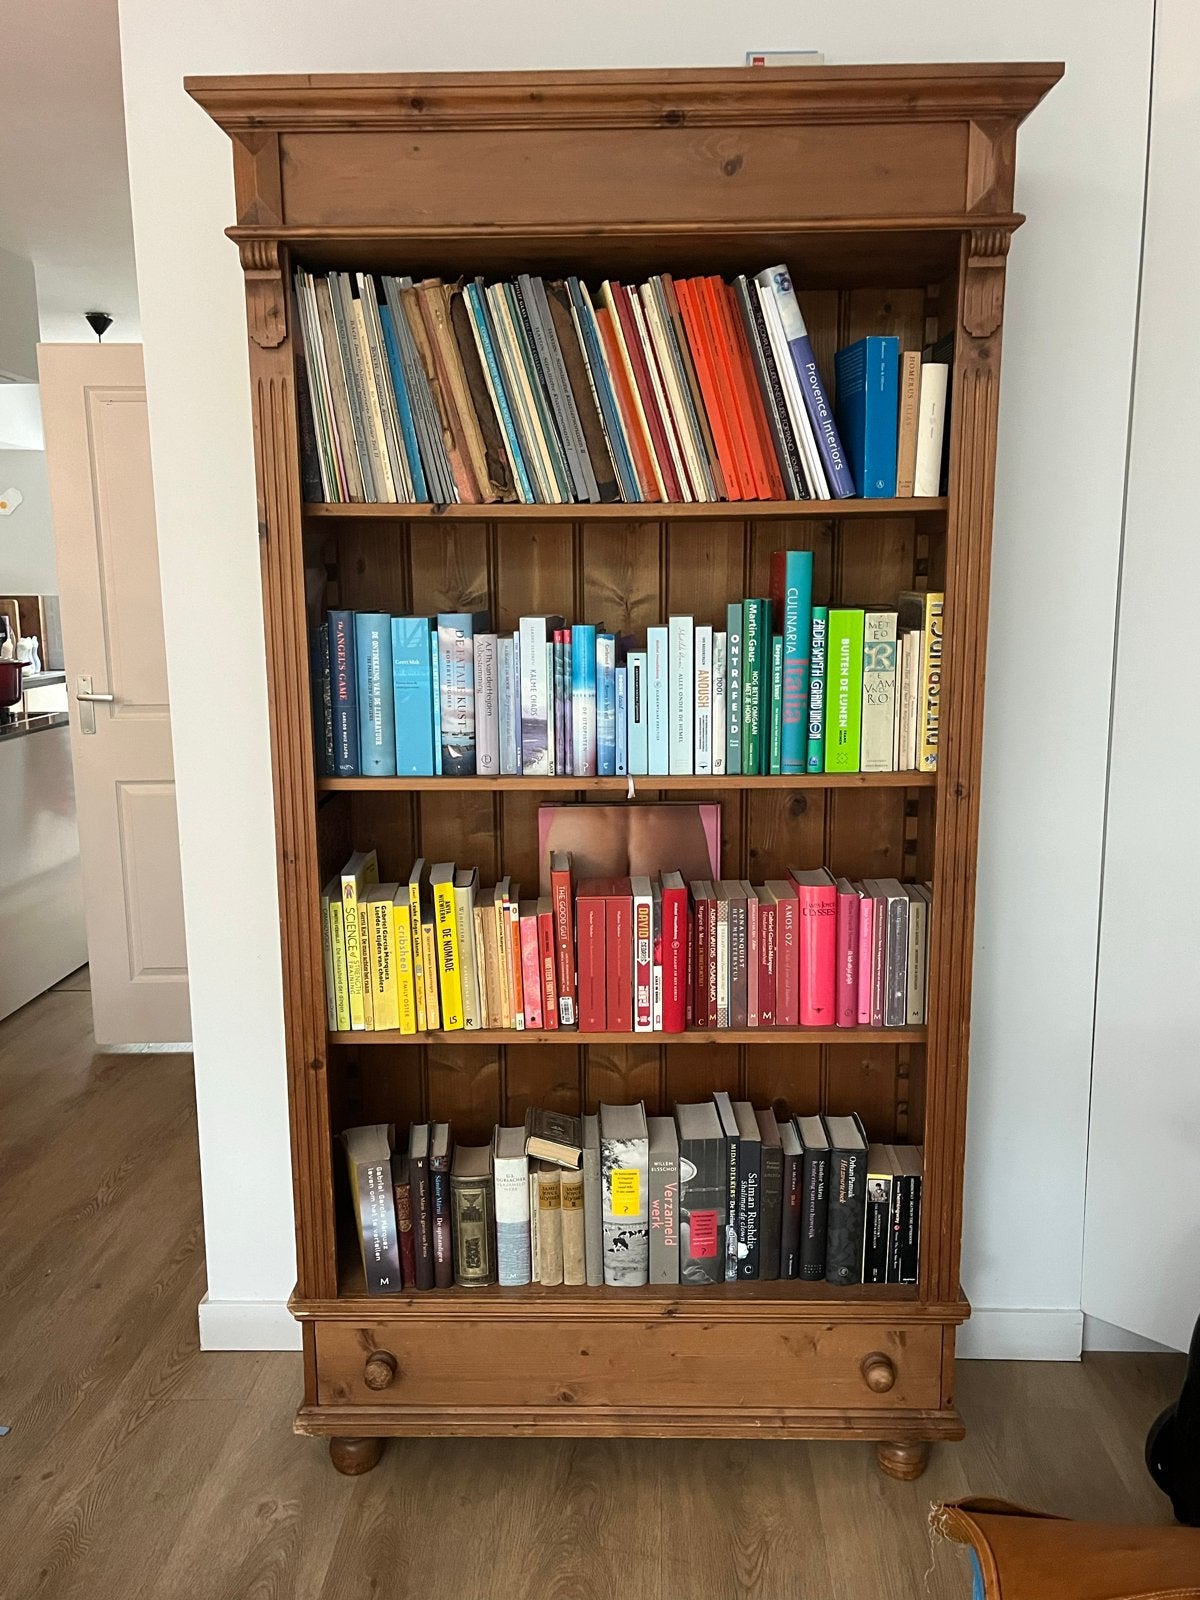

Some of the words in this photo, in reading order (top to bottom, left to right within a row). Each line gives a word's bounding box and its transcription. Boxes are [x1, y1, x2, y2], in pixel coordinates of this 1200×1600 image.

[349, 320, 358, 339] BACH
[513, 280, 522, 300] PHILIP
[518, 300, 528, 318] GLASS
[526, 329, 536, 348] PIANO
[532, 349, 546, 385] COLLECTION
[758, 324, 771, 355] COMPLETE
[781, 418, 789, 430] FOR
[805, 362, 828, 417] Provence
[822, 419, 845, 470] Interiors
[783, 430, 794, 451] PIANO
[748, 604, 756, 636] Martin
[785, 587, 797, 653] CULINARIA
[812, 619, 824, 647] ZADIE
[336, 632, 345, 670] ANGEL'S
[454, 630, 464, 645] DE
[748, 639, 756, 662] Gaus
[371, 640, 379, 680] ONTDEKKING
[455, 650, 465, 695] FATALE
[475, 641, 484, 693] Asbestemming
[811, 647, 823, 676] SMITH
[840, 638, 849, 675] BUITEN
[338, 673, 347, 700] GAME
[697, 669, 709, 707] ANOUSH
[730, 635, 739, 734] ONTRAFELD
[783, 659, 808, 723] Italia
[810, 679, 822, 709] GRAND
[840, 678, 848, 690] DE
[457, 696, 466, 728] KUST
[808, 710, 821, 739] UNION
[839, 693, 848, 726] LIJNEN
[374, 707, 382, 745] LITERATUUR
[437, 894, 446, 922] NIEWIERRA
[457, 906, 466, 942] Wintering
[638, 908, 647, 937] DAVID
[803, 908, 835, 916] ULYSSES
[344, 907, 358, 951] SCIENCE
[442, 928, 451, 937] DE
[397, 925, 410, 972] cribsheet
[442, 940, 454, 972] NOMADE
[353, 960, 361, 994] STRENGTH
[376, 1166, 384, 1191] Gabriel
[747, 1172, 757, 1208] Salman
[369, 1190, 376, 1201] om
[436, 1217, 442, 1225] De
[651, 1199, 663, 1228] werk
[663, 1182, 677, 1245] Verzameld
[746, 1211, 757, 1248] Rushdie
[372, 1228, 381, 1260] vertellen
[436, 1226, 444, 1262] opstandigen
